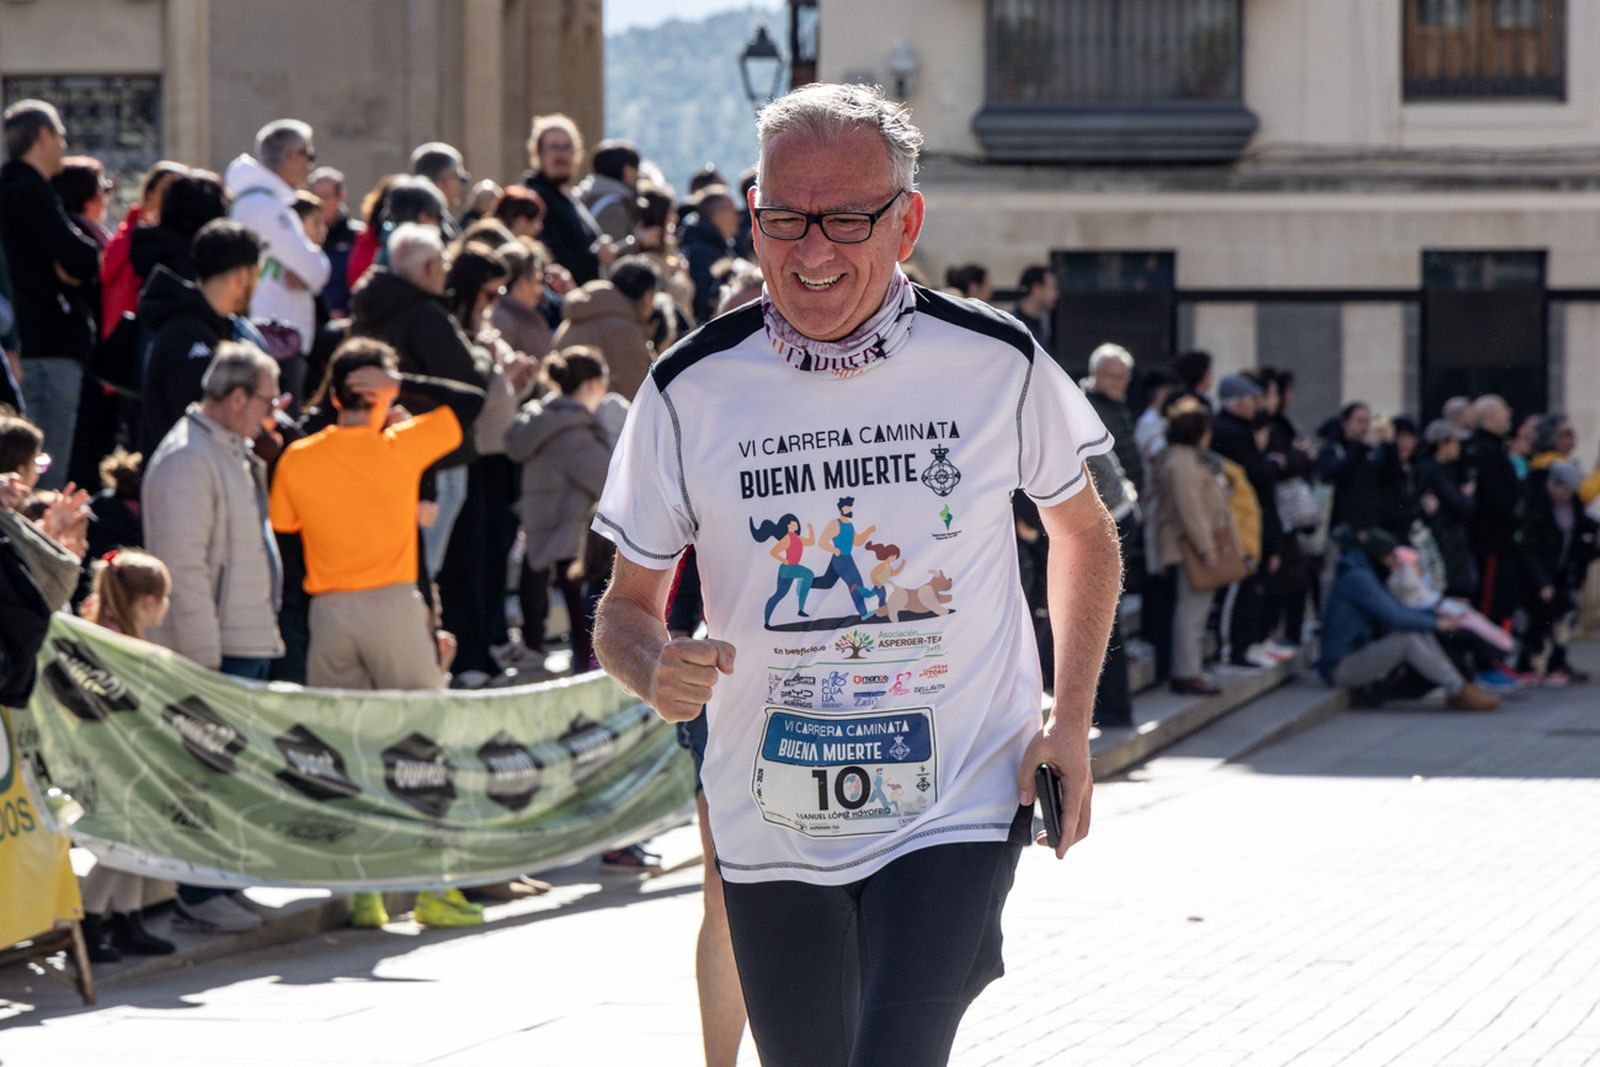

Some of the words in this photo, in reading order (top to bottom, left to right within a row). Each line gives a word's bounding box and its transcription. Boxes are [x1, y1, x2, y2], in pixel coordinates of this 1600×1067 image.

[738, 440, 757, 458] VI
[761, 427, 854, 456] CARRERA
[859, 420, 961, 444] CAMINATA
[739, 463, 816, 500] BUENA
[823, 453, 918, 490] MUERTE
[784, 719, 794, 732] VI
[795, 721, 843, 737] CARRERA
[846, 720, 910, 737] CAMINATA
[778, 737, 819, 761] BUENA
[823, 741, 882, 761] MUERTE
[812, 766, 870, 810] 10
[0, 796, 36, 842] OS
